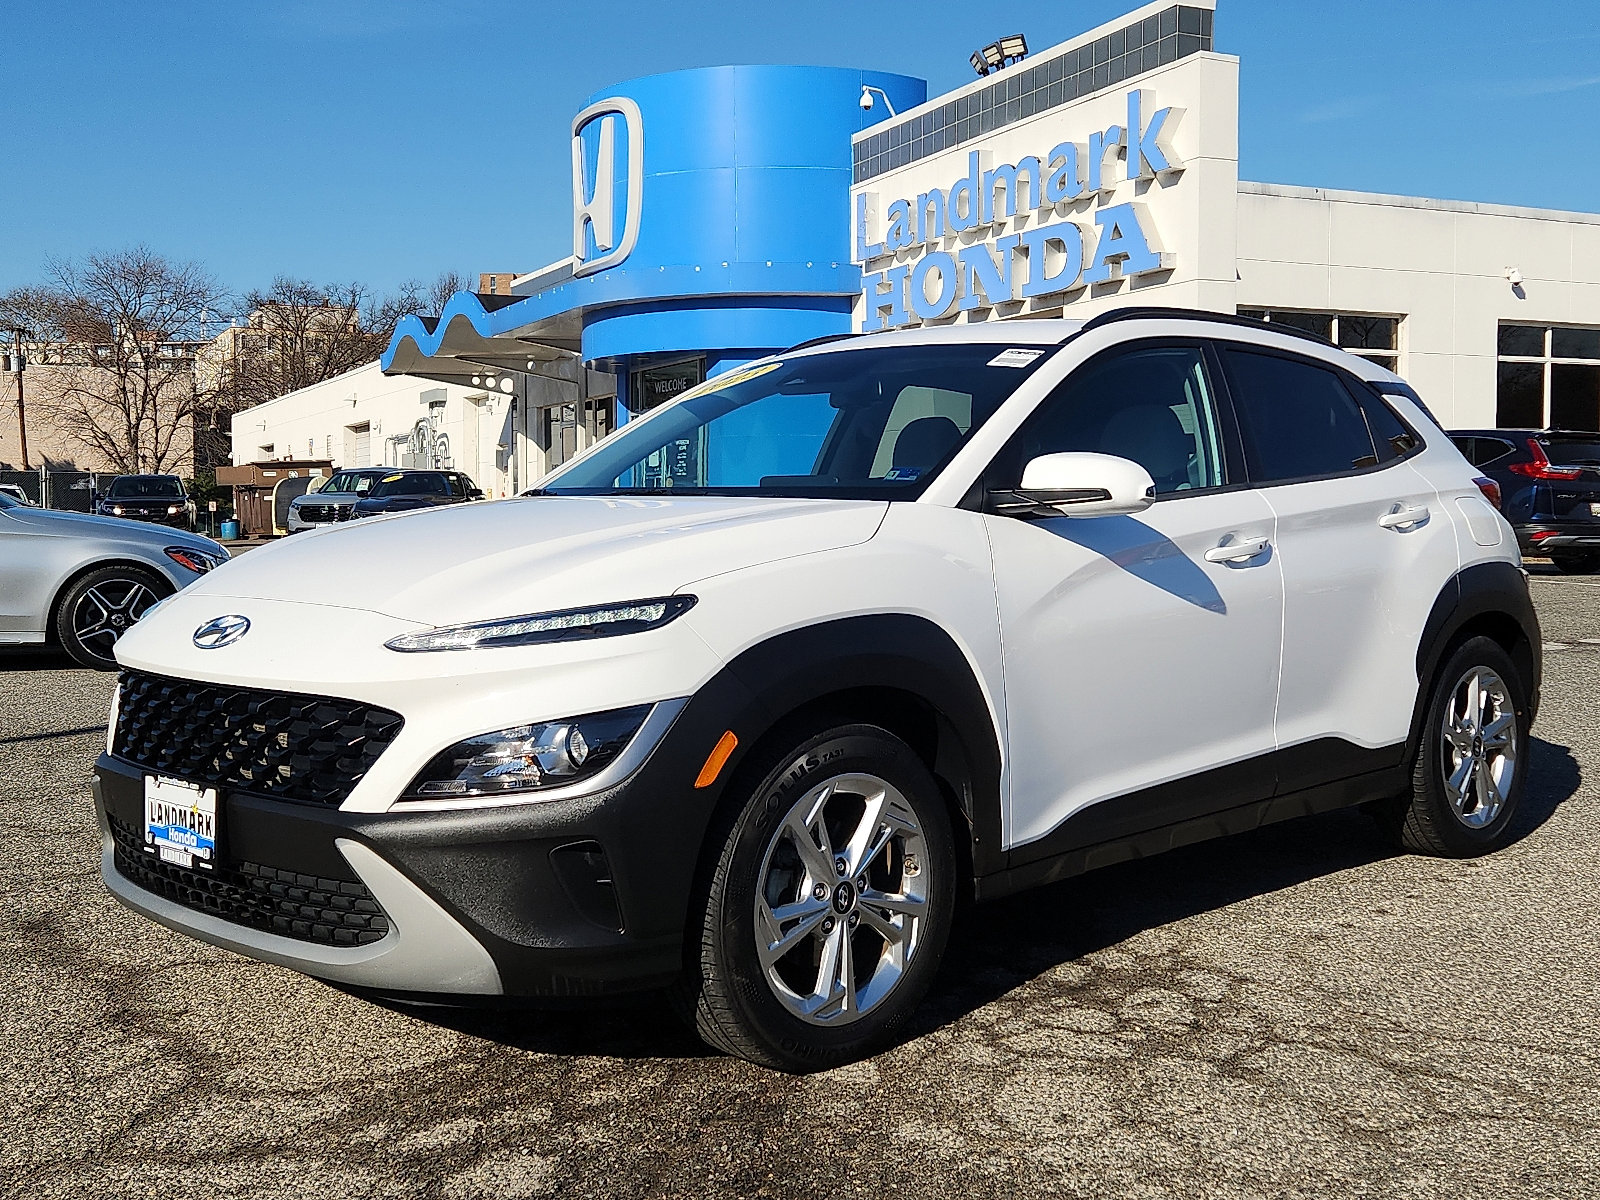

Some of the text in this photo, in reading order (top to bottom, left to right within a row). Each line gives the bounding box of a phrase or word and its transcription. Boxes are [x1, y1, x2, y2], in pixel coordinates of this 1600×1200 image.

[855, 89, 1178, 262] Landmark
[861, 202, 1164, 333] HONDA
[654, 378, 687, 393] WELCOME
[149, 801, 213, 838] LANDMARK
[755, 754, 821, 829] SOLUS
[168, 827, 198, 847] Honda
